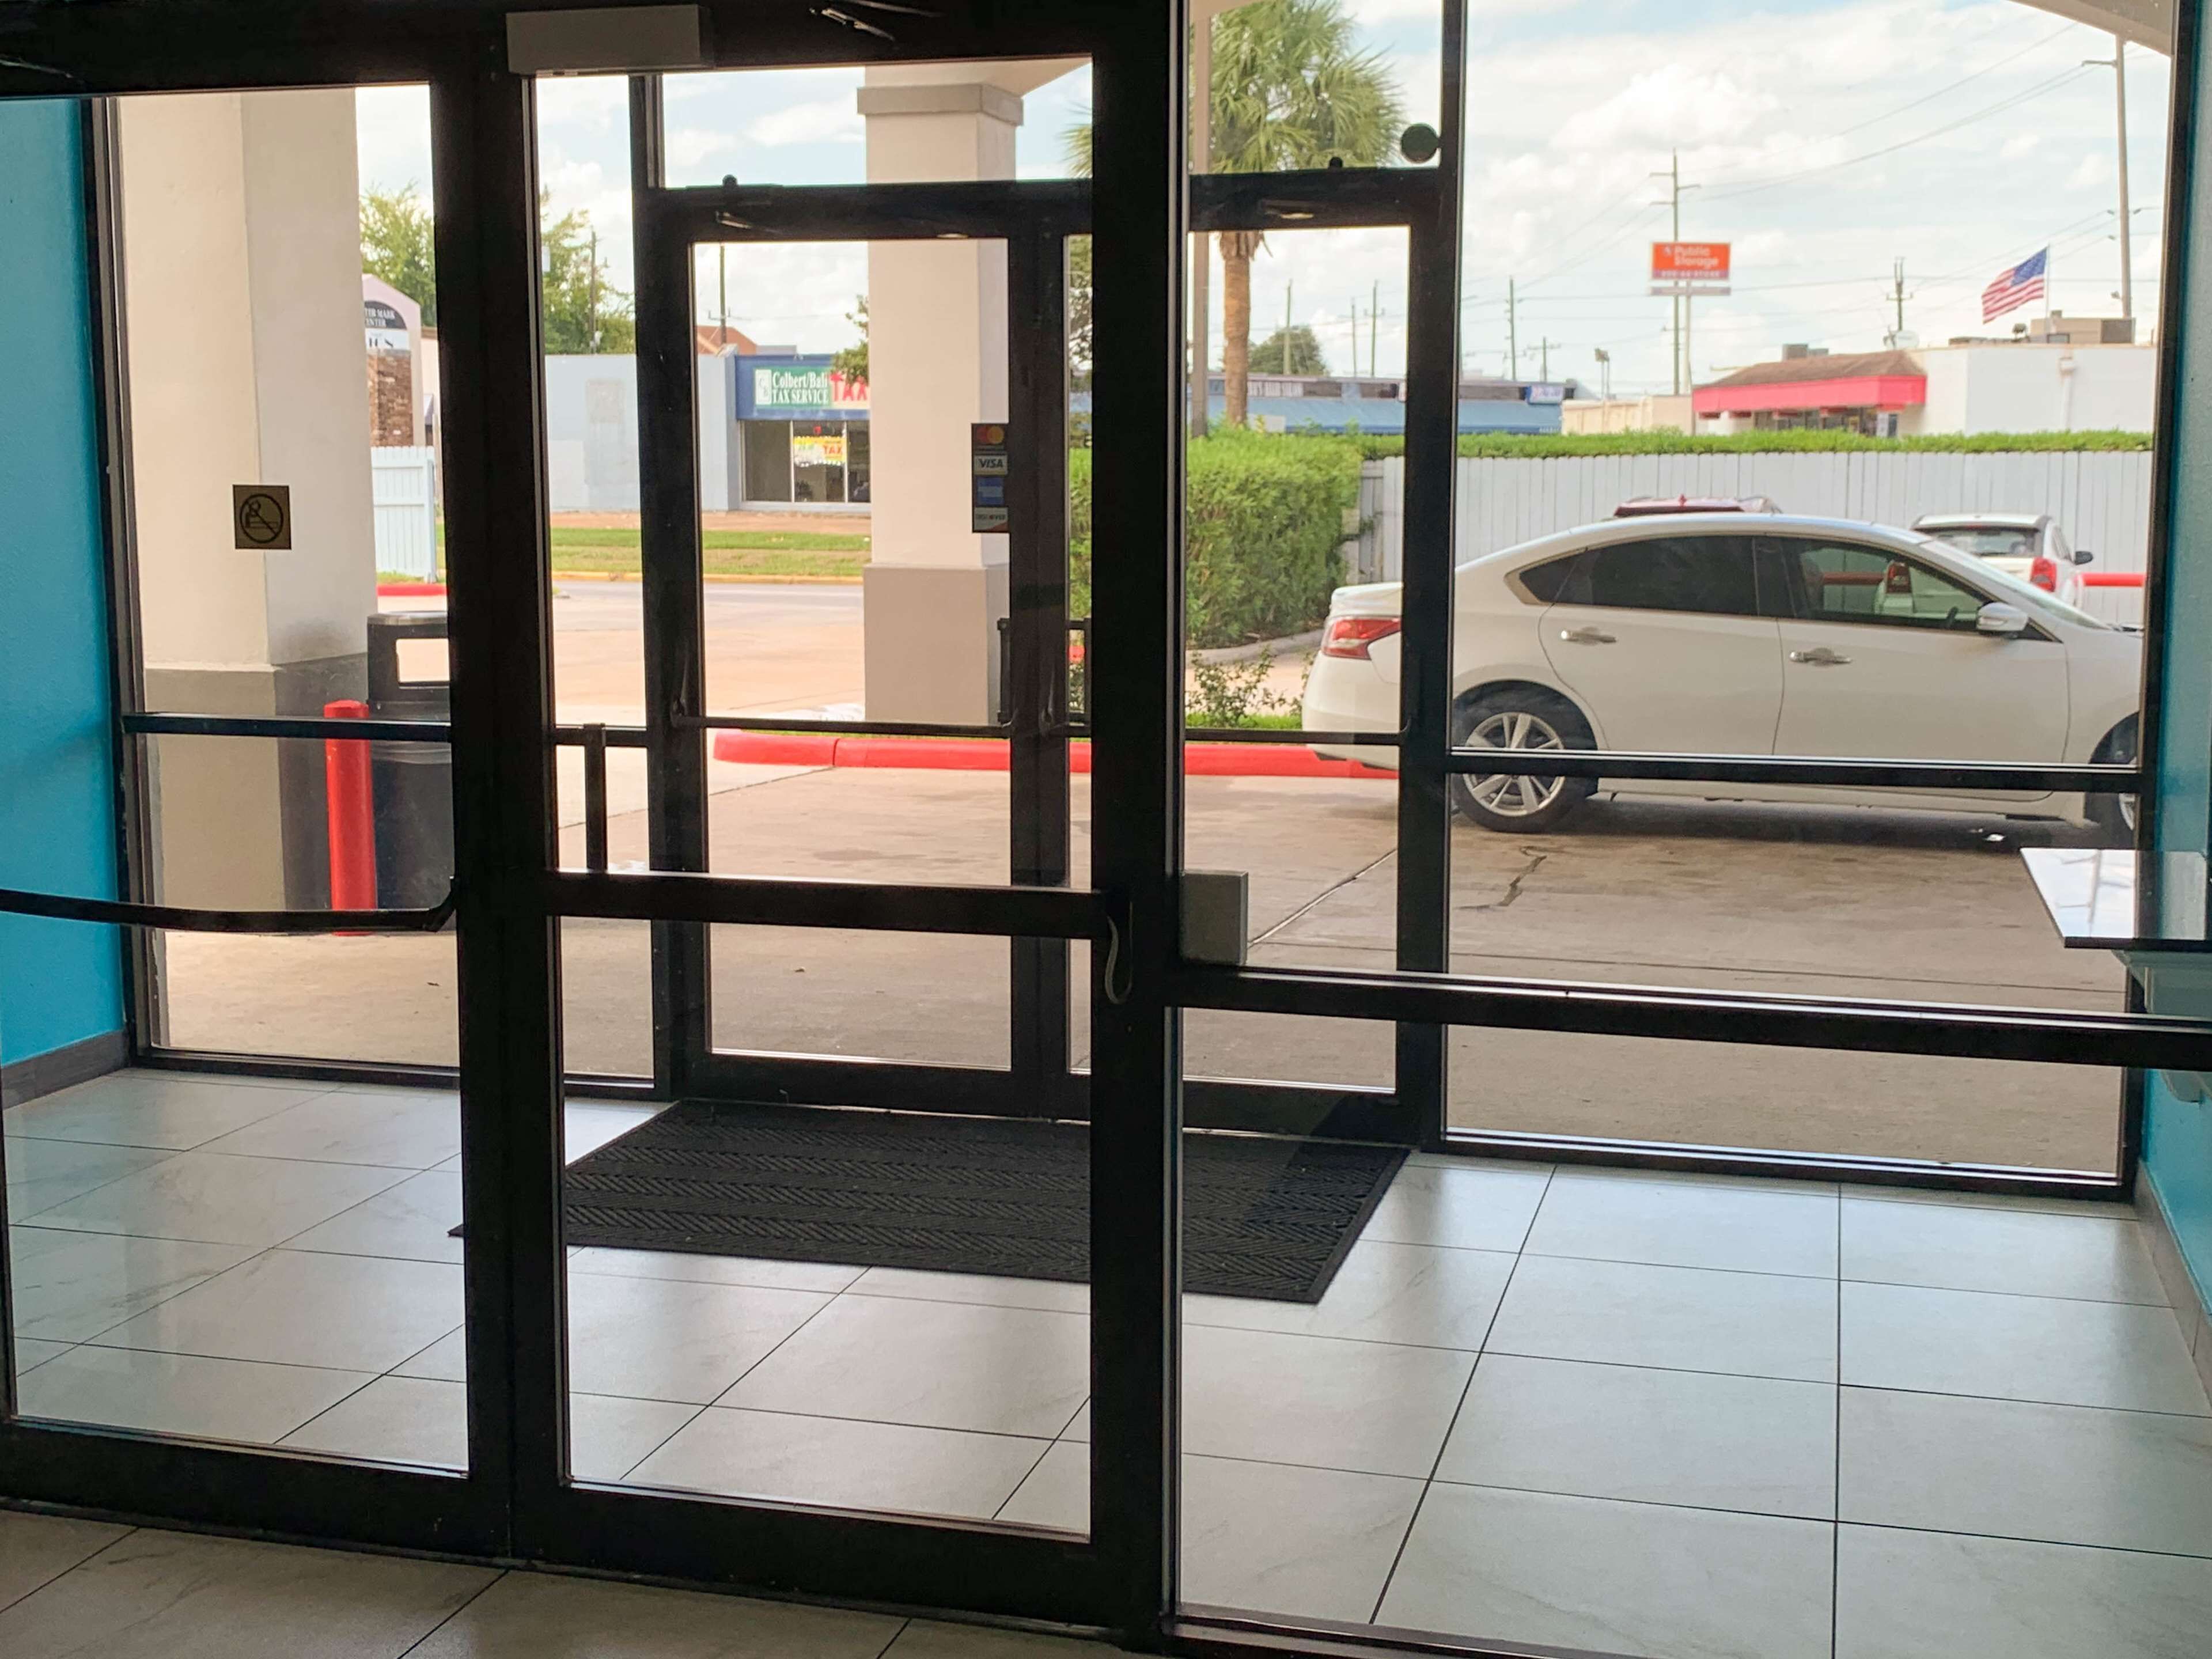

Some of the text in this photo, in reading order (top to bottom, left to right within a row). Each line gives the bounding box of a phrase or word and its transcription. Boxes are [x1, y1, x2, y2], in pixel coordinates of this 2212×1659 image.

[365, 318, 387, 327] ENTER
[772, 389, 829, 404] TAX SERVICE
[979, 459, 1003, 468] VISA
